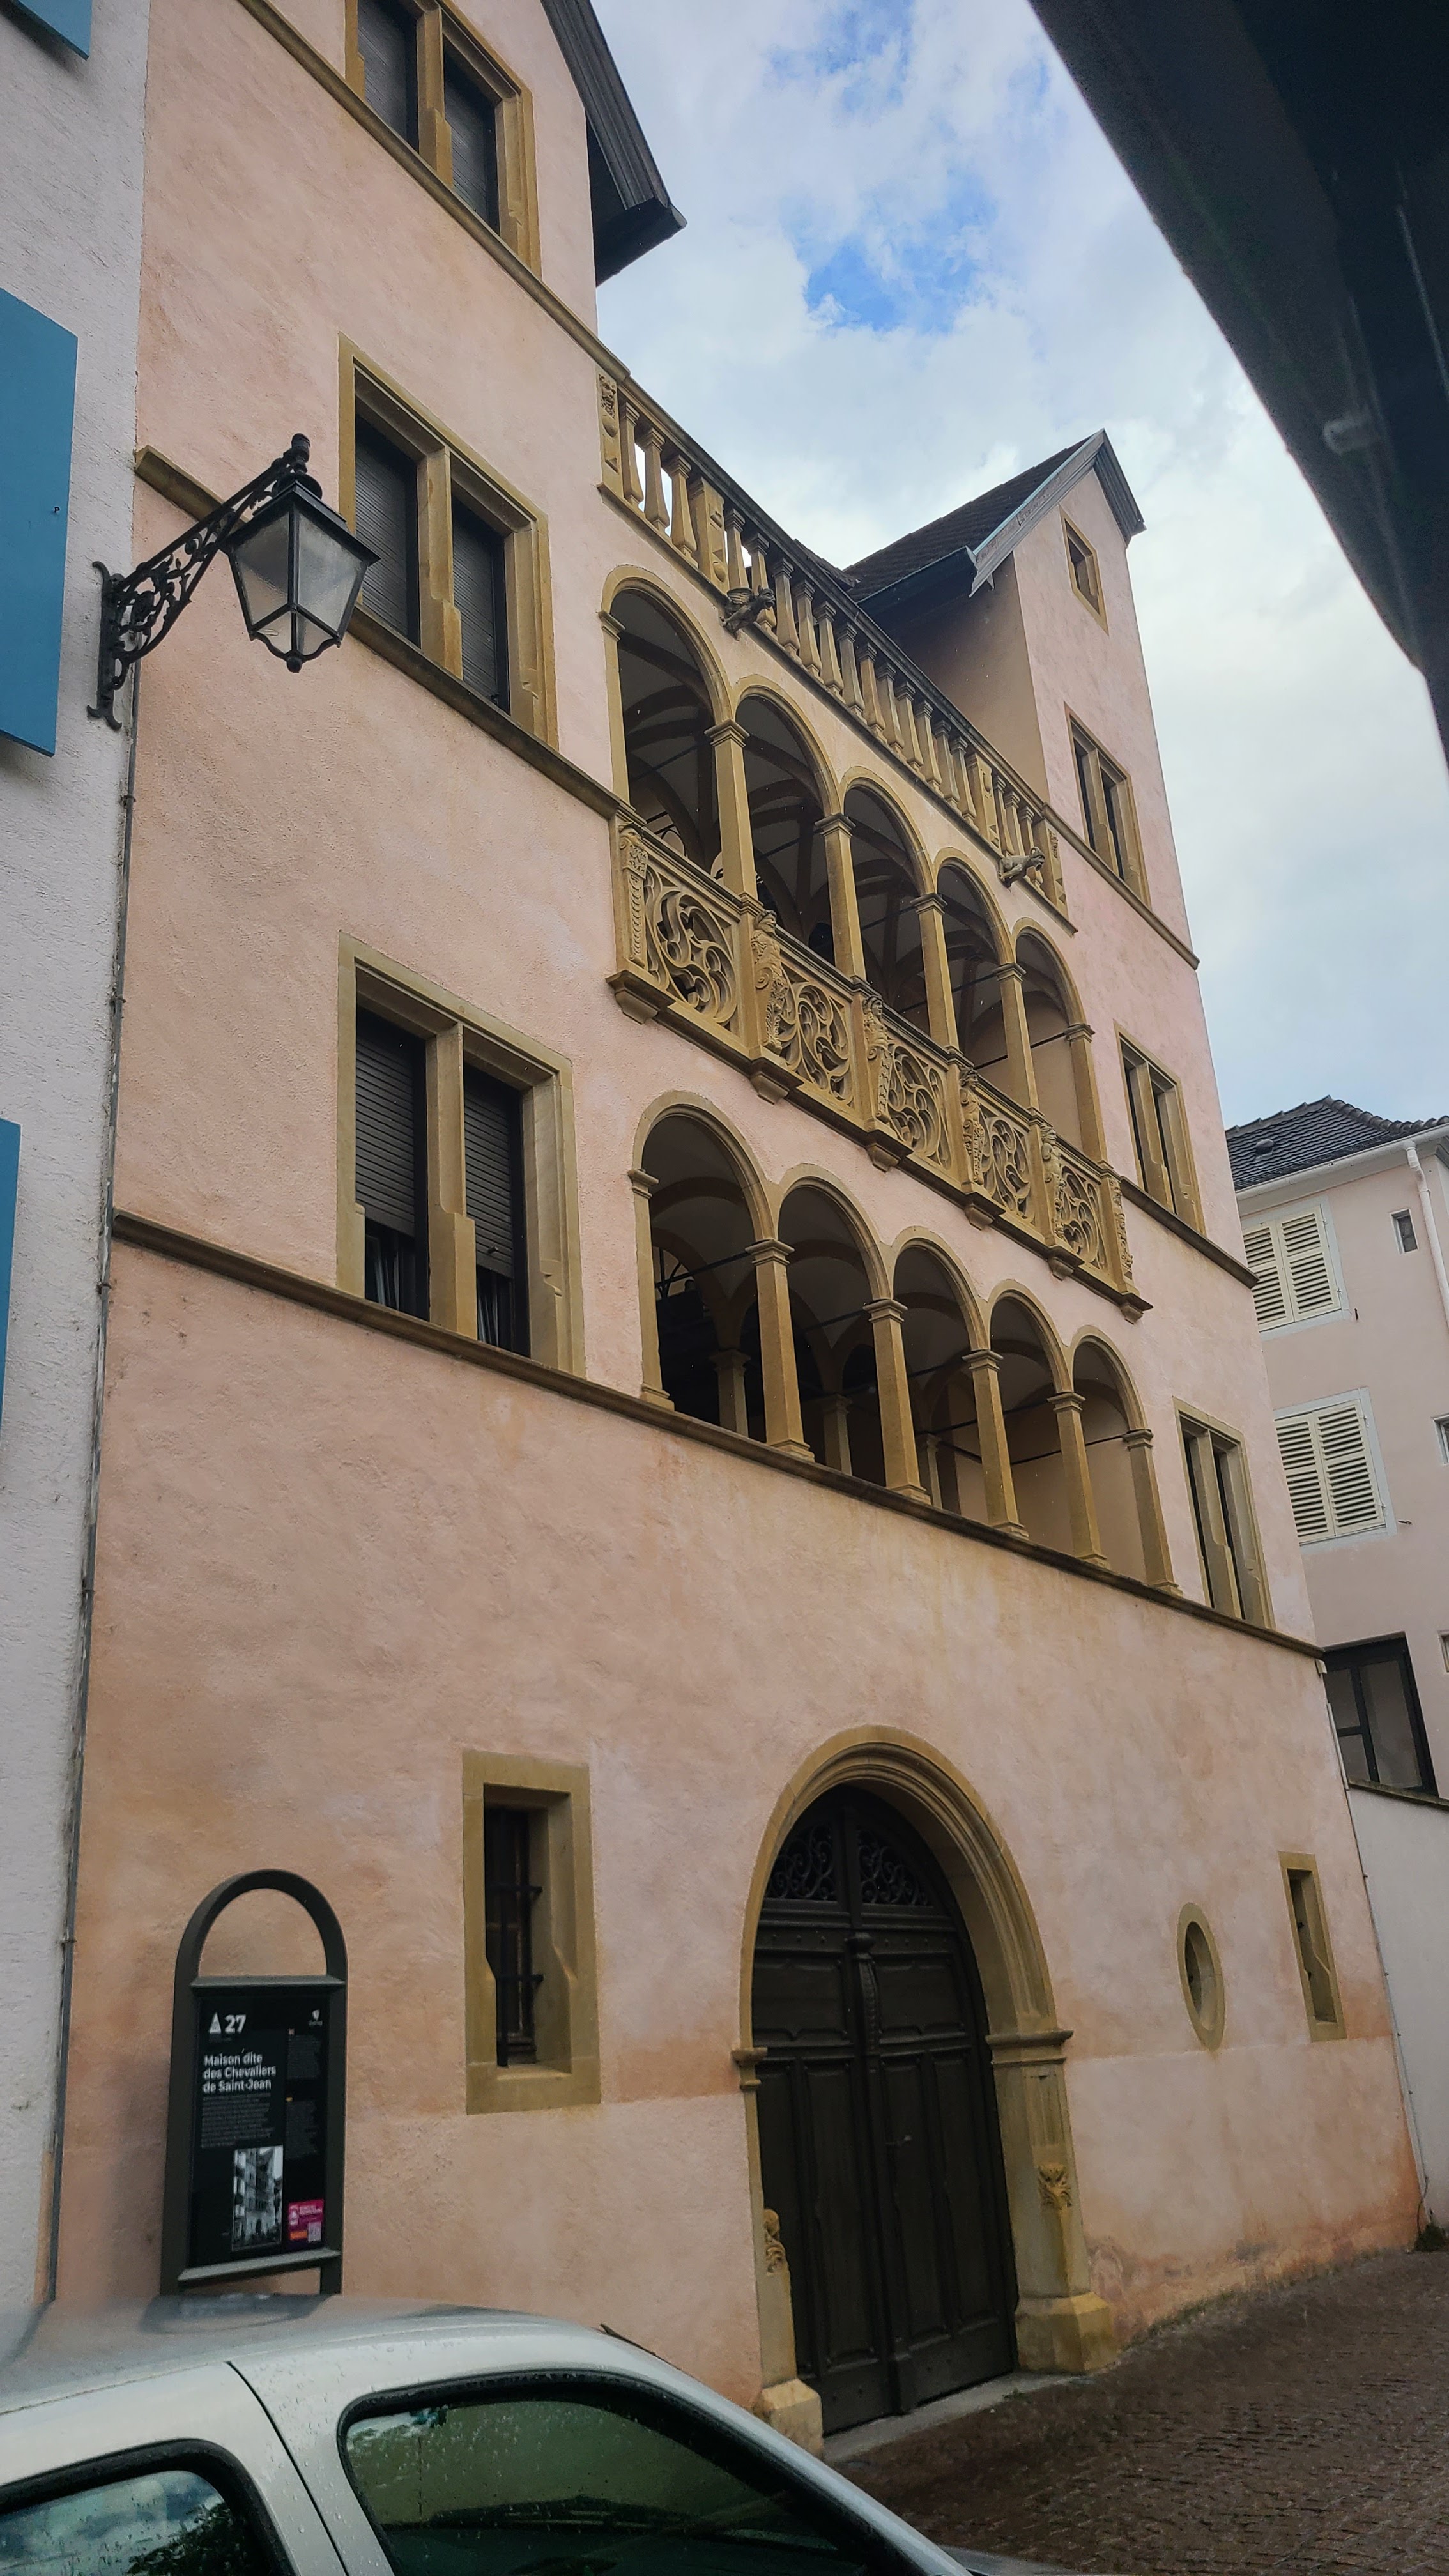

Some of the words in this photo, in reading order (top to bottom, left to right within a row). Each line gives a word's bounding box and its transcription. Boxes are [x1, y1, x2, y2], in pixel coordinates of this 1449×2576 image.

[225, 2014, 247, 2034] 27
[204, 2053, 241, 2067] Maison
[243, 2051, 263, 2065] dite
[203, 2067, 222, 2080] des
[224, 2065, 277, 2078] Chevaliers
[203, 2082, 217, 2094] de
[218, 2078, 272, 2092] Saint-Jean
